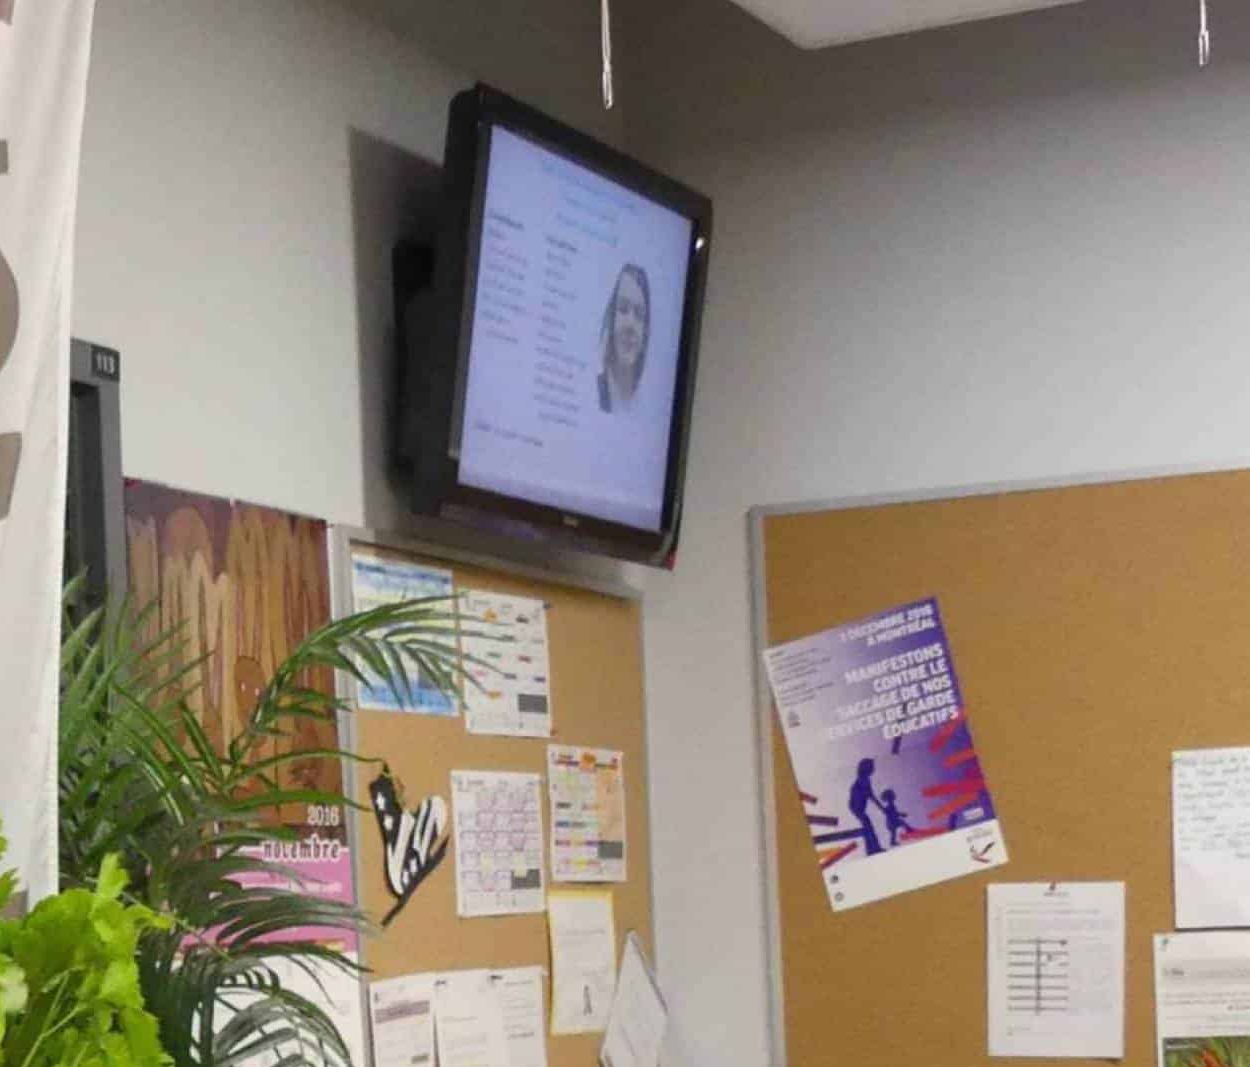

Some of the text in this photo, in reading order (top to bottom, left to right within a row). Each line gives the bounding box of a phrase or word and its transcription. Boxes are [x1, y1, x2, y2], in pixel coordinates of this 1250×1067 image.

[845, 642, 943, 684] MANIFESTONS
[872, 657, 948, 694] CONTRE LE
[900, 682, 921, 702] DE
[922, 673, 952, 697] NOS
[886, 704, 906, 723] DE
[907, 688, 957, 717] GARDE
[261, 833, 341, 862] novembre
